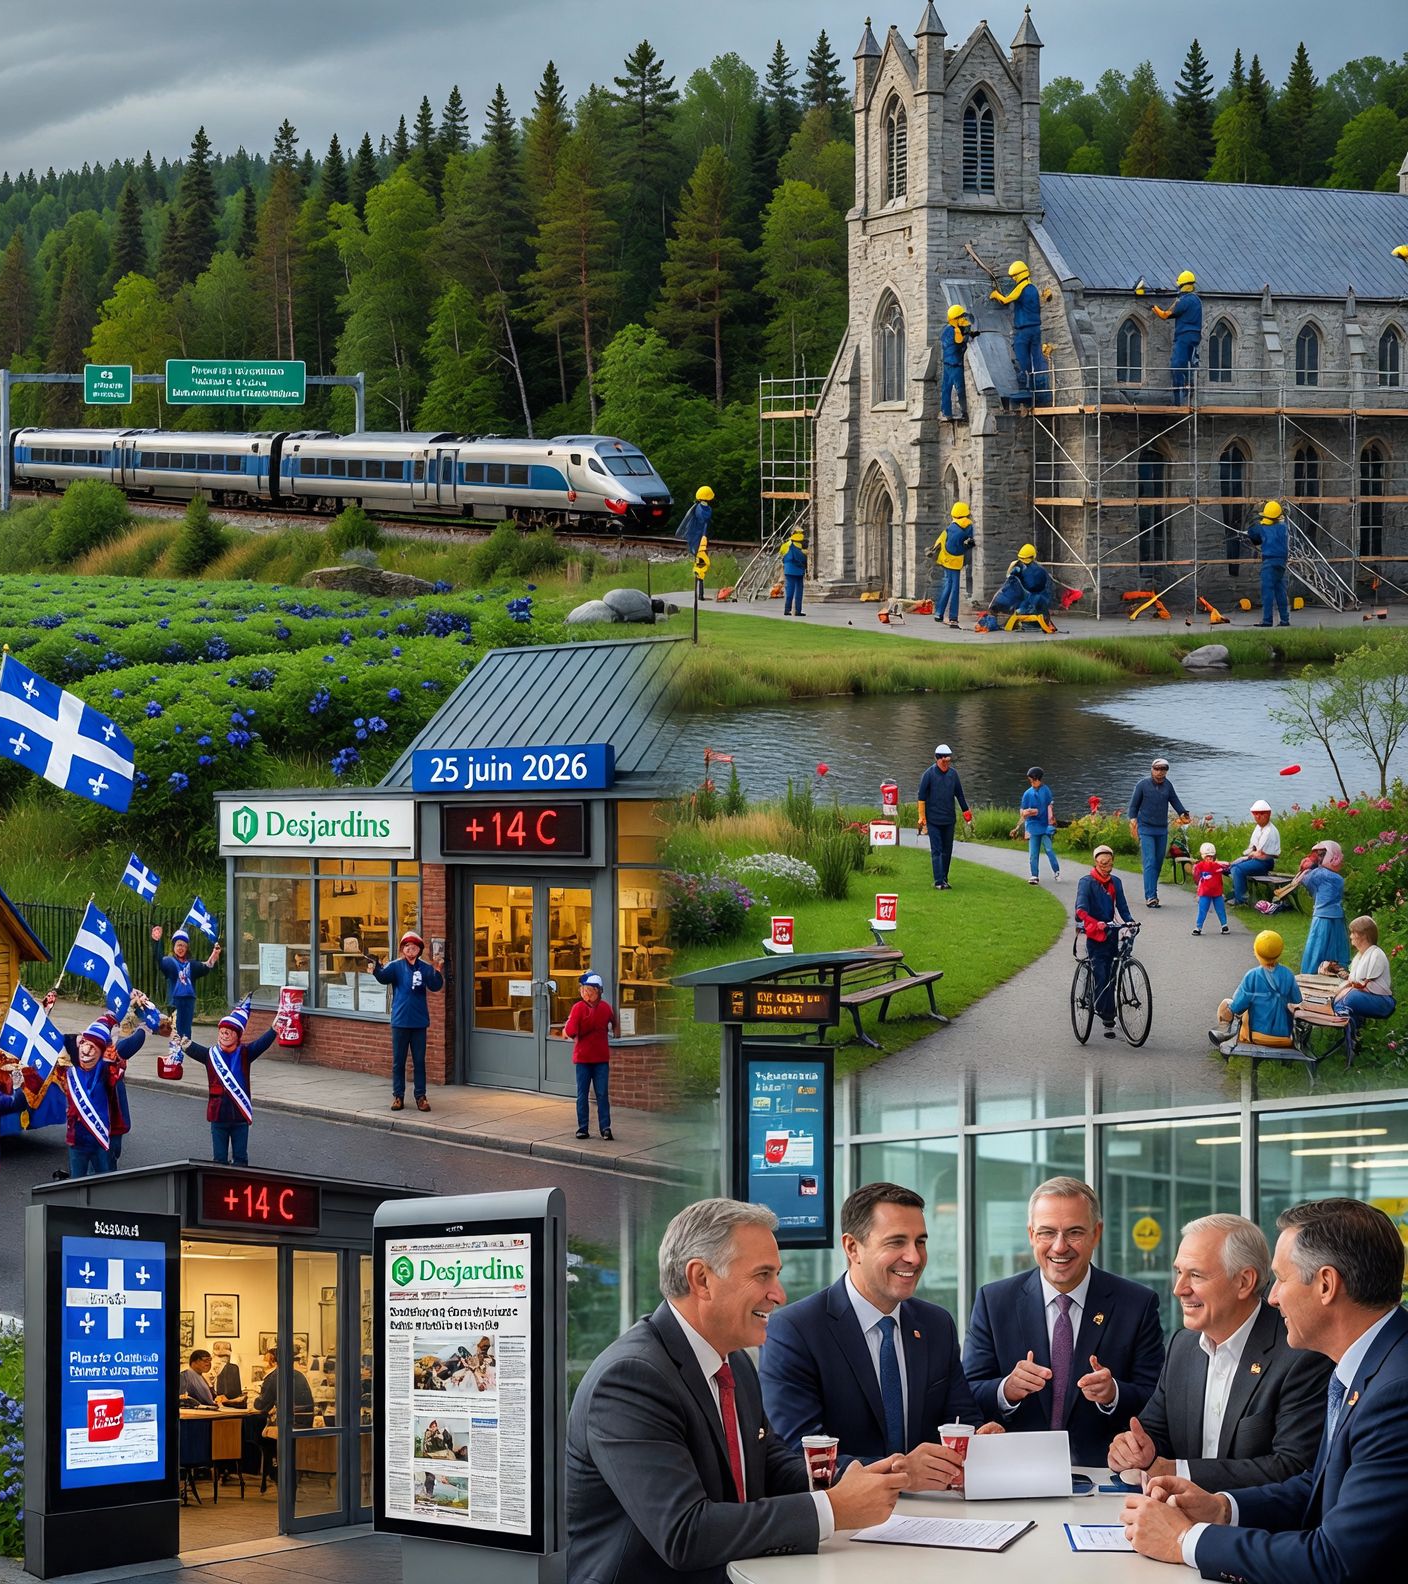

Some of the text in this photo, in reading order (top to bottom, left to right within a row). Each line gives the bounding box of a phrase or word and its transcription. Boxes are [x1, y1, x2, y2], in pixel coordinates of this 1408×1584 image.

[430, 753, 588, 790] 25 juin 2026
[266, 810, 390, 844] Desjardins
[465, 810, 557, 846] +14 C
[223, 1185, 294, 1220] +14 C
[419, 1256, 524, 1287] Desjardins
